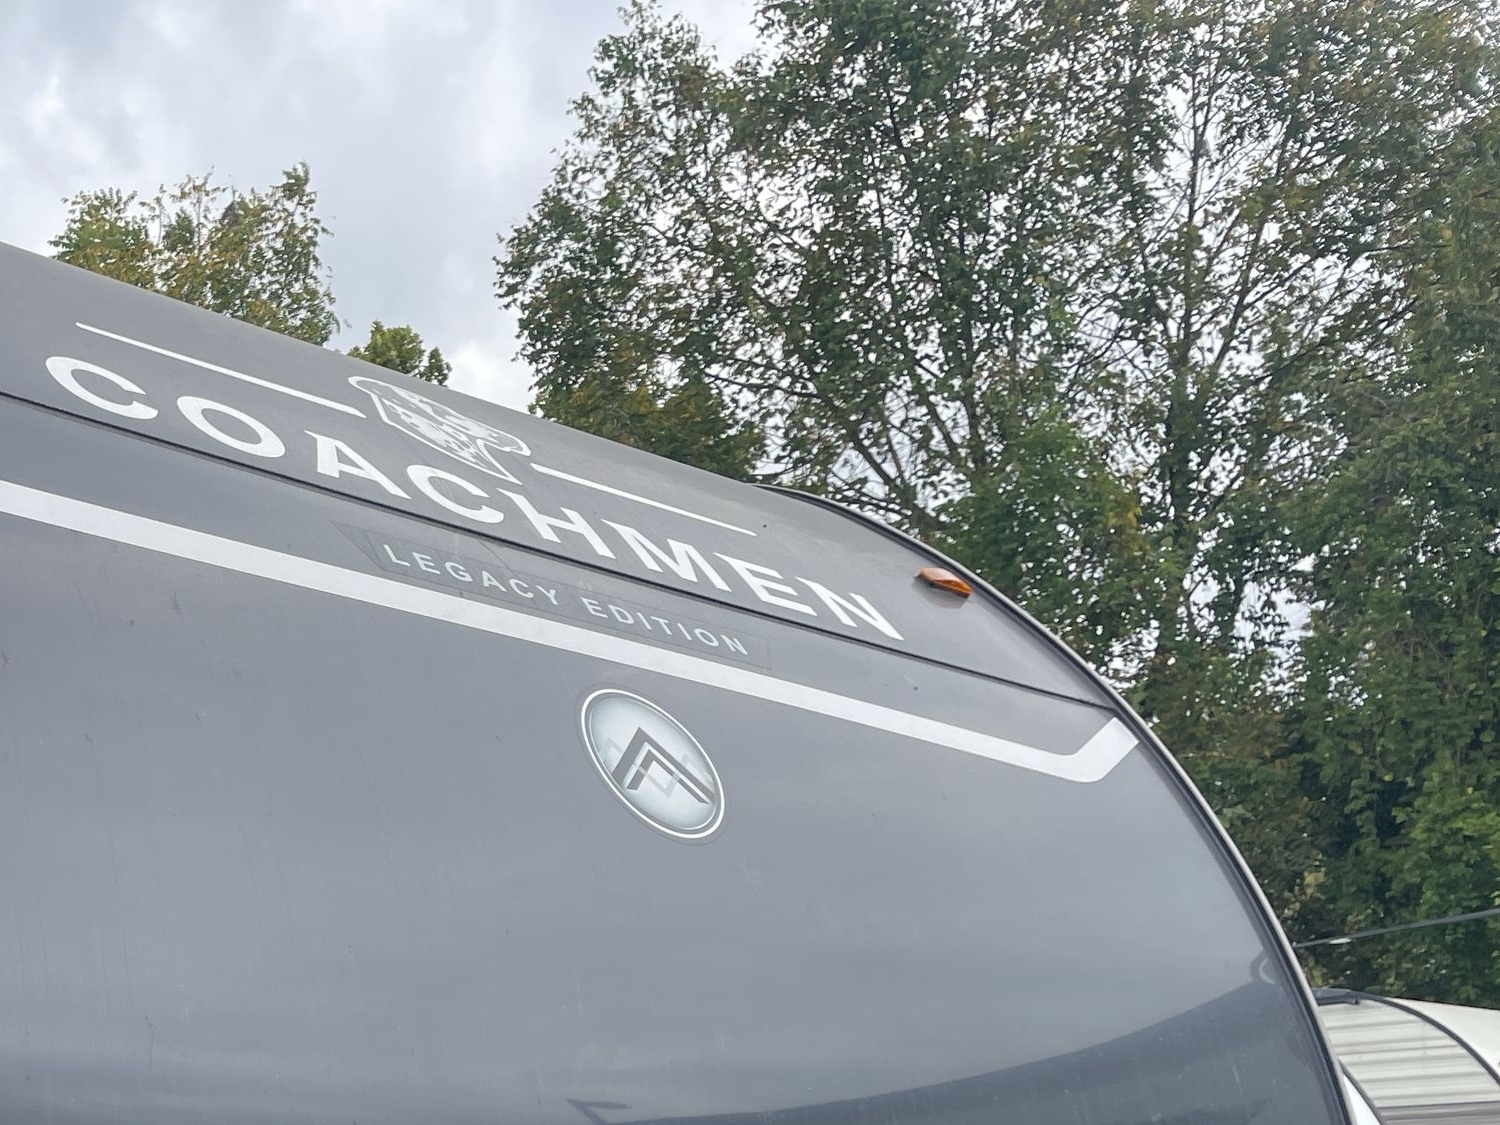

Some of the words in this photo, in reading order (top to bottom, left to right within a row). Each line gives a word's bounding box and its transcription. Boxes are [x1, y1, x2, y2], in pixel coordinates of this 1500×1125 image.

[46, 356, 904, 640] COACHMEN
[383, 544, 559, 606] LEGACY
[581, 597, 748, 656] EDITION
